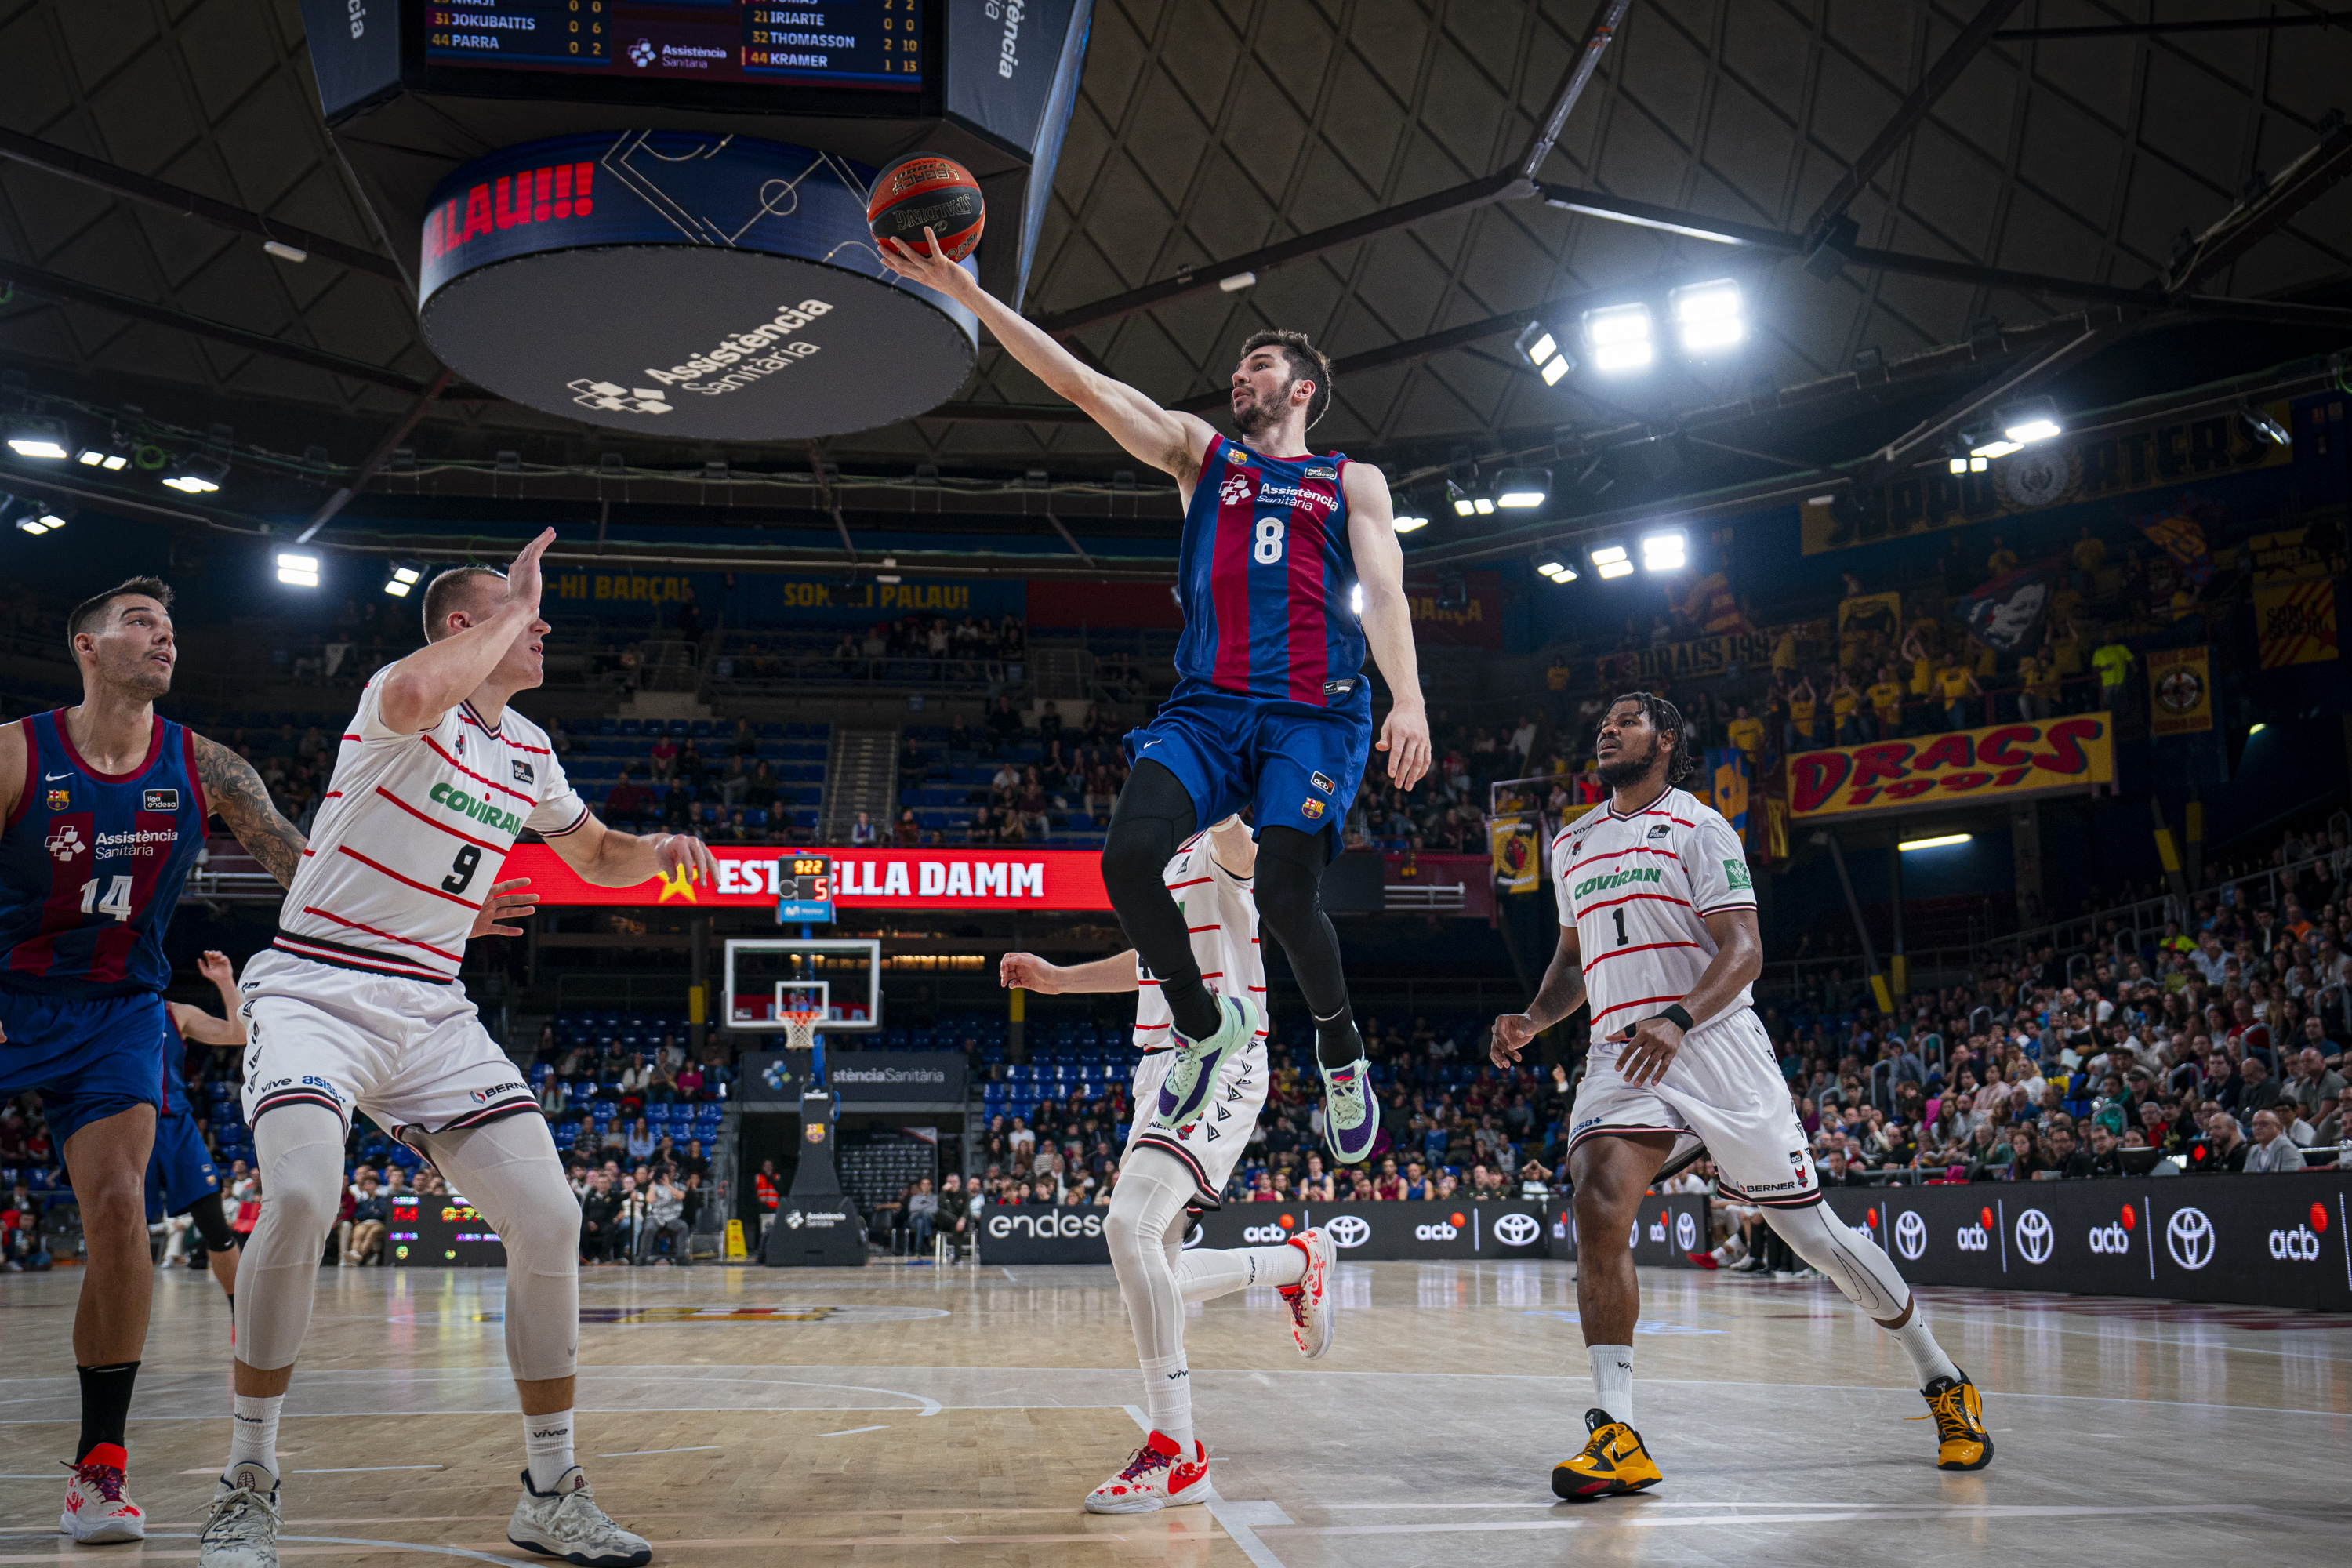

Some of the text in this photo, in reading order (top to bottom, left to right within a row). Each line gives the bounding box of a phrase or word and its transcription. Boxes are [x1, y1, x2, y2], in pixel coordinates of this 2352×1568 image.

[452, 13, 536, 31] JOKUBAITIS
[569, 20, 579, 33] 0
[593, 22, 601, 34] 6
[753, 10, 915, 31] 21 IRIARTE 0 0
[432, 33, 601, 55] 44 PARRA 0 2
[662, 44, 728, 59] Assistència
[752, 31, 918, 52] 32 THOMASSON 2 10
[662, 56, 708, 69] Sanitària
[750, 52, 768, 64] 44
[770, 52, 828, 67] KRAMER
[885, 59, 891, 71] 1
[892, 169, 960, 195] LEGACY
[895, 194, 973, 231] SPALDING
[644, 299, 835, 386] Assistència
[681, 340, 822, 396] Sanitària
[1256, 495, 1312, 512] Sanitària
[1261, 483, 1339, 513] Assistència
[1254, 517, 1285, 564] 8
[541, 575, 587, 599] -HI
[880, 585, 970, 610] PALAU!
[1791, 719, 2103, 812] DRACS
[1313, 778, 1329, 790] acb
[1846, 766, 2034, 806] 1991
[95, 829, 179, 846] Assistència
[95, 844, 154, 861] Sanitària
[441, 844, 482, 895] 9
[717, 858, 1044, 897] ESTLLA DAMM
[79, 875, 134, 922] 14
[812, 877, 829, 902] 5
[1613, 906, 1629, 947] 1
[261, 1077, 292, 1094] vive
[1791, 1154, 1802, 1163] acb
[1746, 1181, 1795, 1192] BERNER
[988, 1208, 1107, 1239] endes
[1243, 1216, 1287, 1243] acb
[1415, 1215, 1457, 1242] acb
[1650, 1220, 1667, 1243] acb
[1957, 1221, 1988, 1251] acb
[2089, 1221, 2129, 1254] acb
[2269, 1224, 2321, 1261] acb
[1247, 1255, 1257, 1286] vive
[532, 1427, 568, 1439] vive
